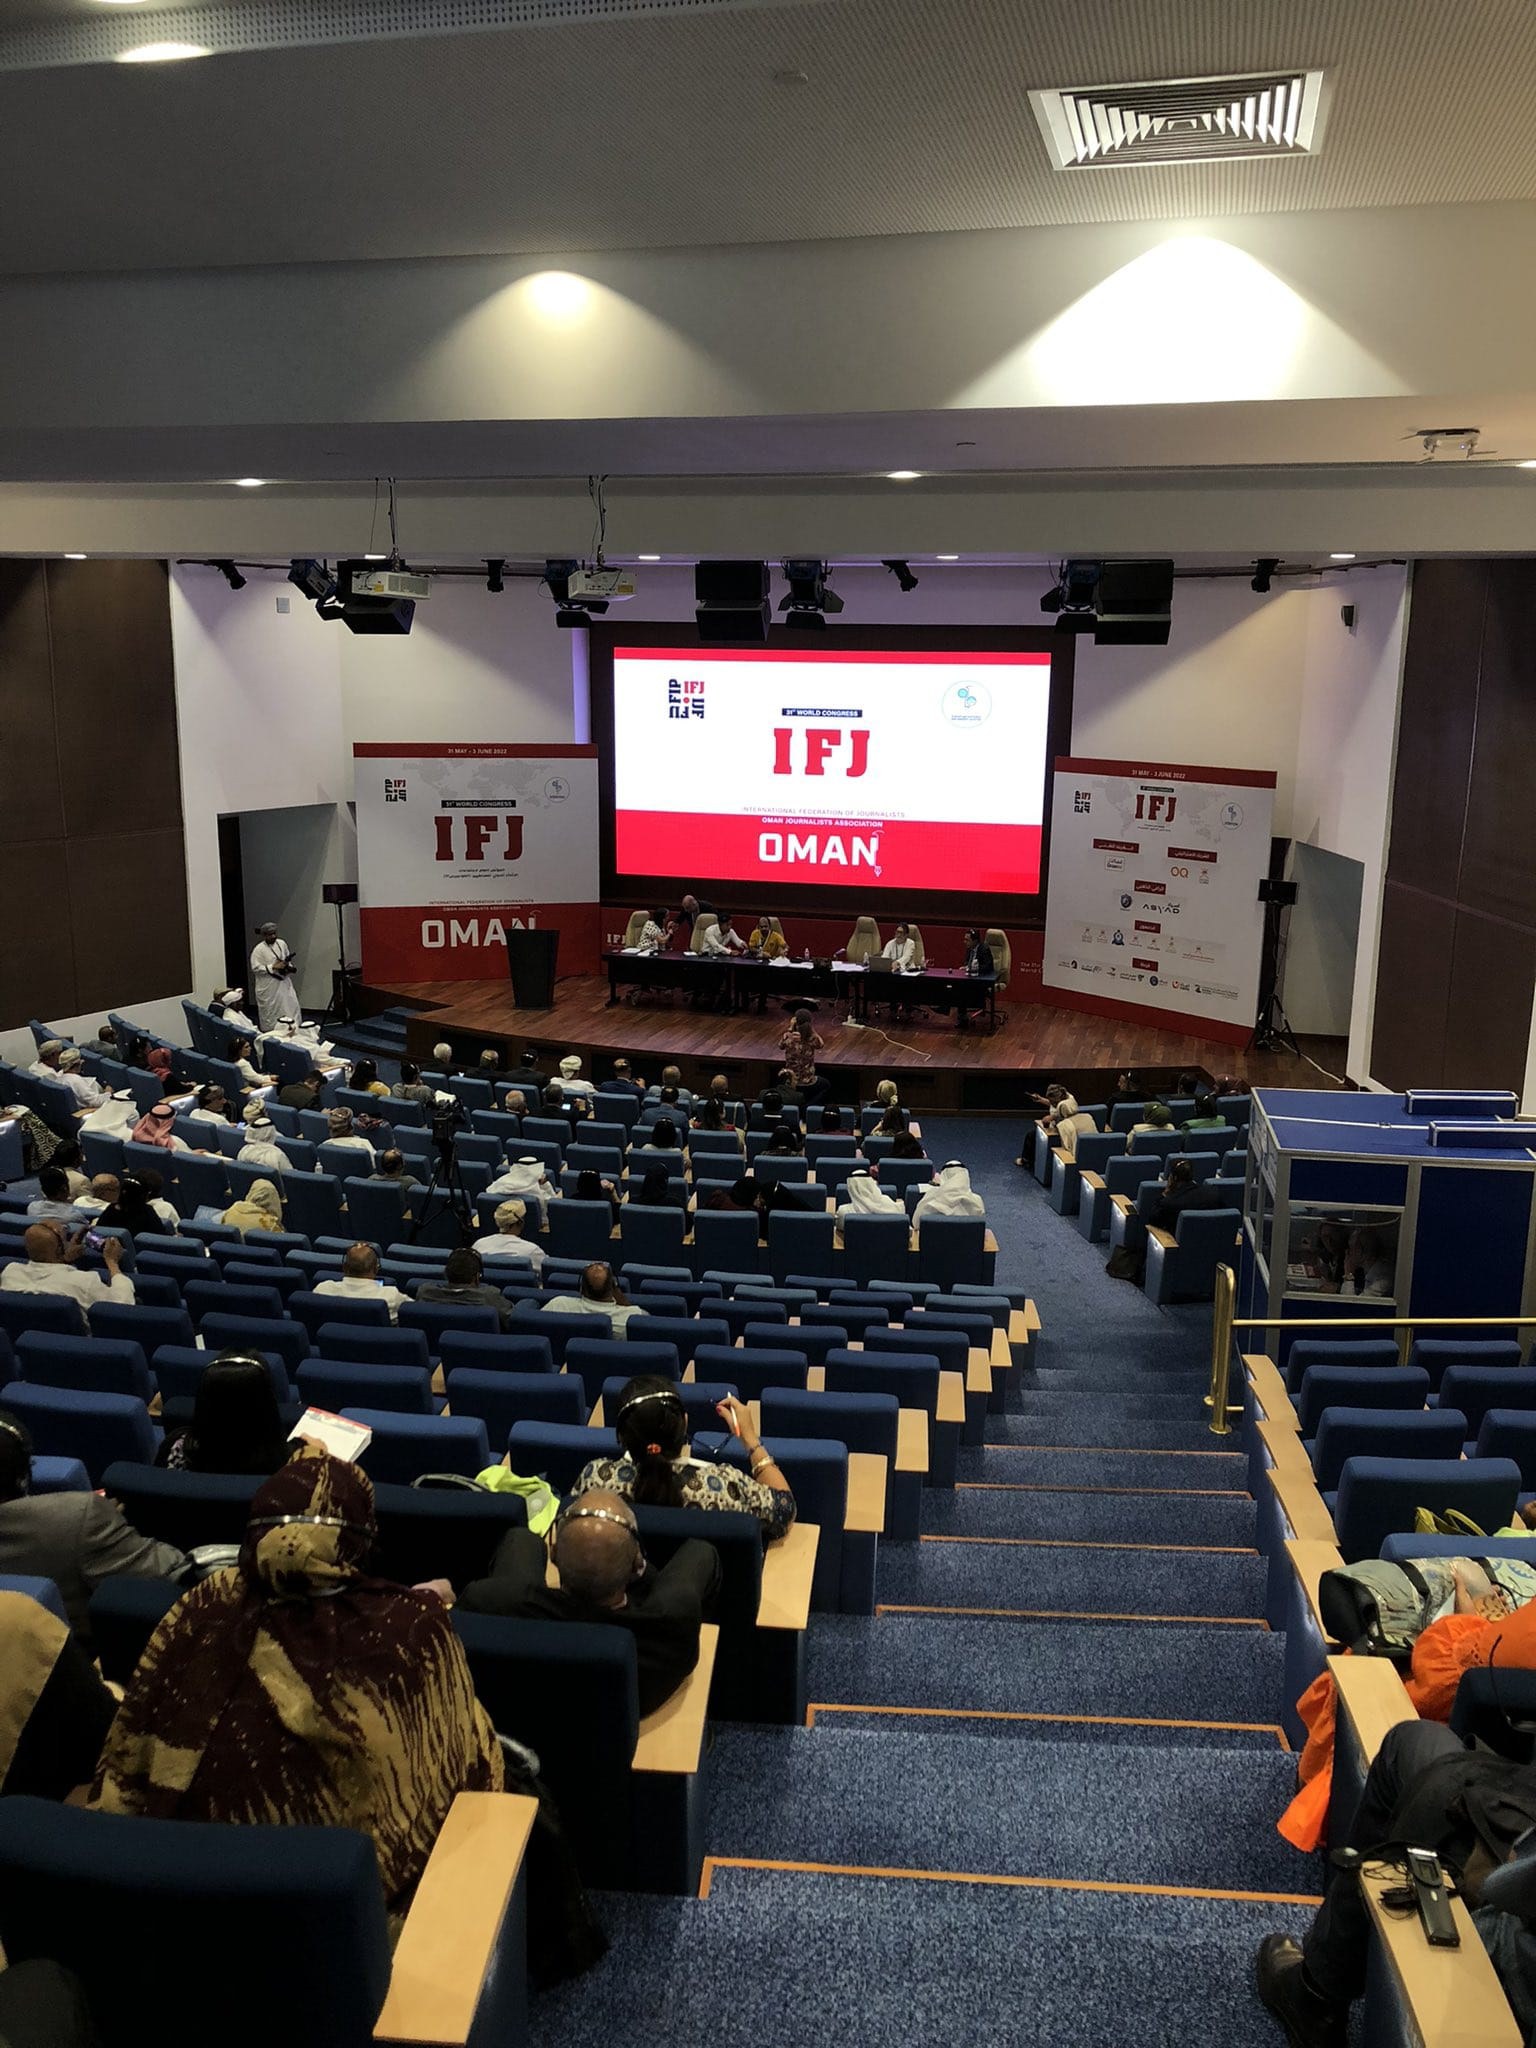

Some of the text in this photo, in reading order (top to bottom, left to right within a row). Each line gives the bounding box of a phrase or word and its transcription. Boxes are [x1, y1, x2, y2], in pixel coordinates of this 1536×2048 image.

[684, 680, 705, 694] IFJ
[773, 728, 870, 777] IFJ
[799, 808, 843, 816] FEDERATION
[856, 810, 905, 818] JOURNALISTS
[1135, 794, 1177, 822] IFJ
[785, 818, 833, 826] JOURNALISTS
[834, 819, 883, 828] ASSOCIATION
[434, 815, 524, 861] IFJ
[758, 832, 879, 867] OMAN
[1170, 866, 1188, 878] OQ
